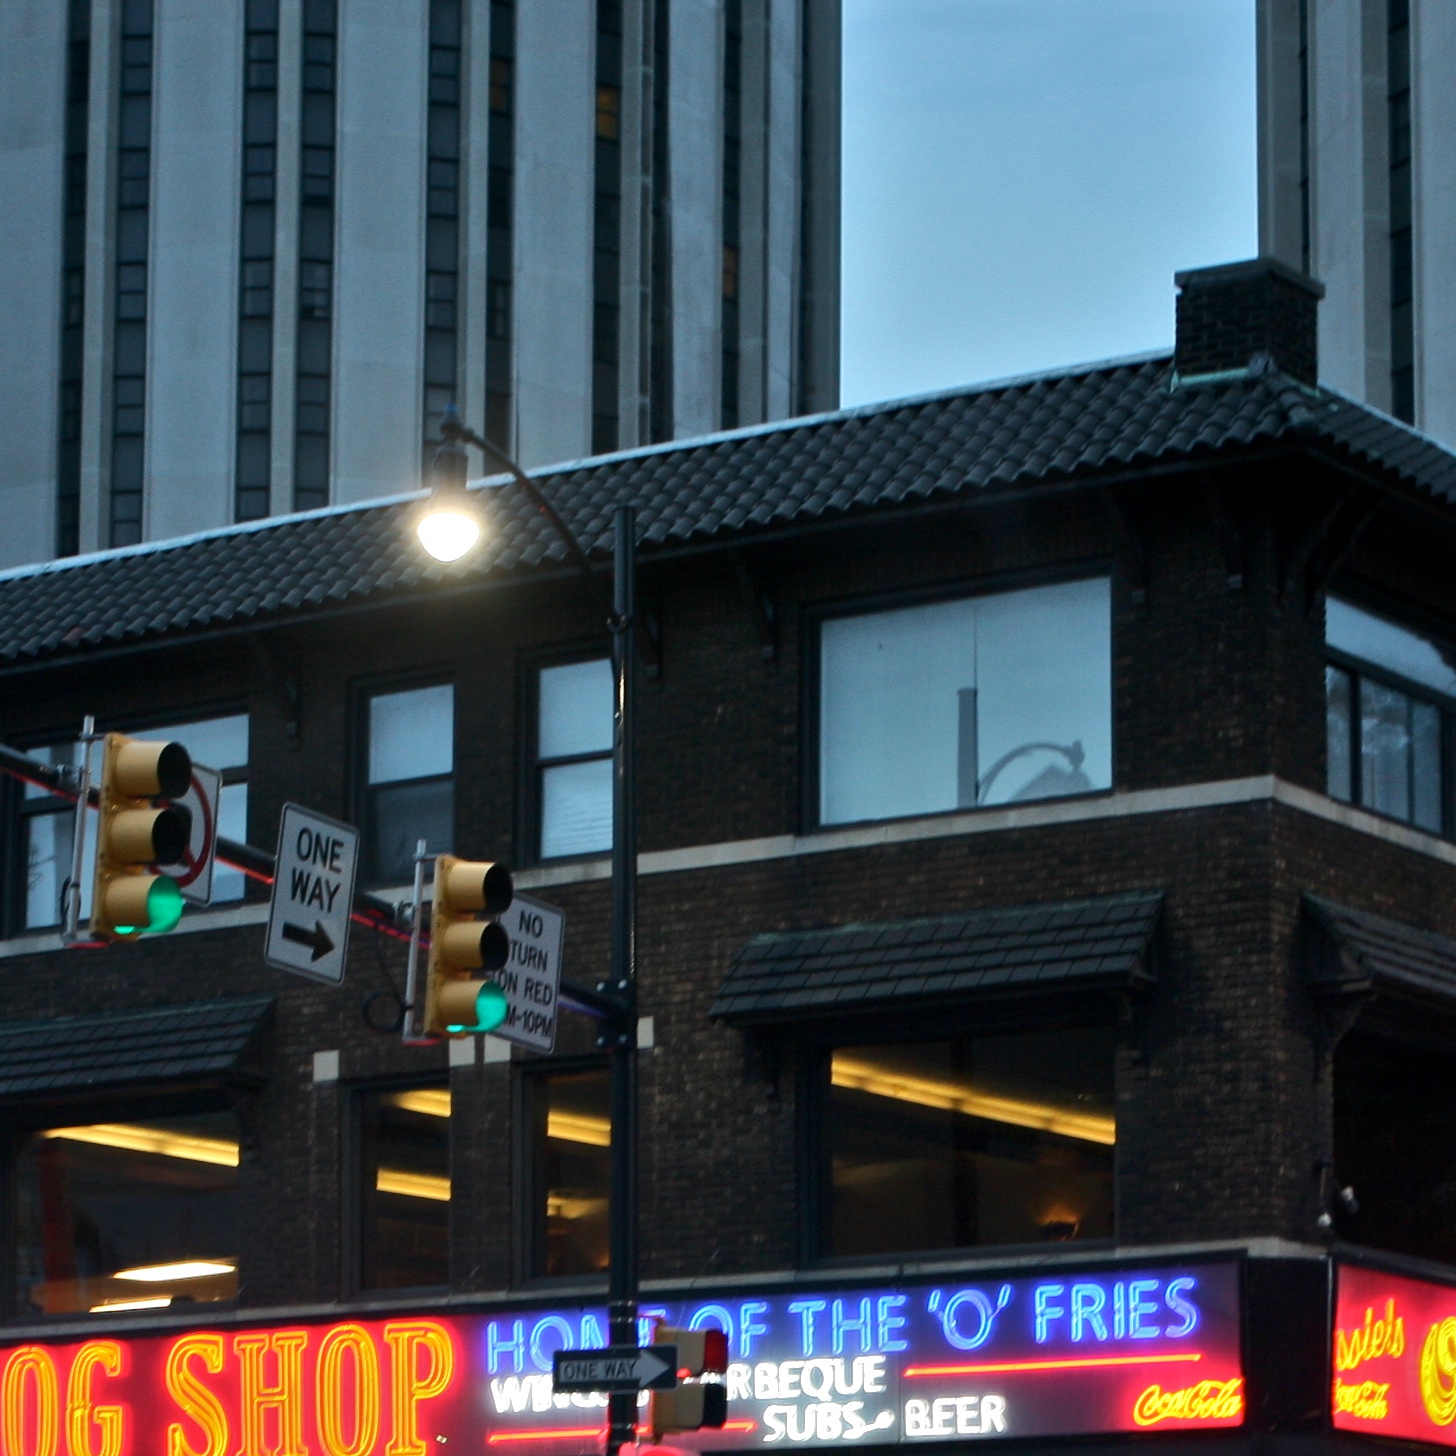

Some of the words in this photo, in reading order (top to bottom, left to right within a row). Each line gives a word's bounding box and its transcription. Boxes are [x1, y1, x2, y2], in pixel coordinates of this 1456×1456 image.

[297, 827, 344, 874] ONE
[291, 866, 341, 913] WAY
[518, 910, 544, 938] NO
[510, 938, 549, 972] TURN
[498, 969, 519, 994] ON
[525, 977, 553, 1005] RED
[789, 1296, 908, 1356] THE
[1035, 1277, 1198, 1343] FRIES
[1337, 1298, 1405, 1371] ssie's
[563, 1357, 599, 1381] ONE
[605, 1355, 640, 1378] WAY
[762, 1402, 867, 1443] SUBS
[905, 1396, 1007, 1437] BEER
